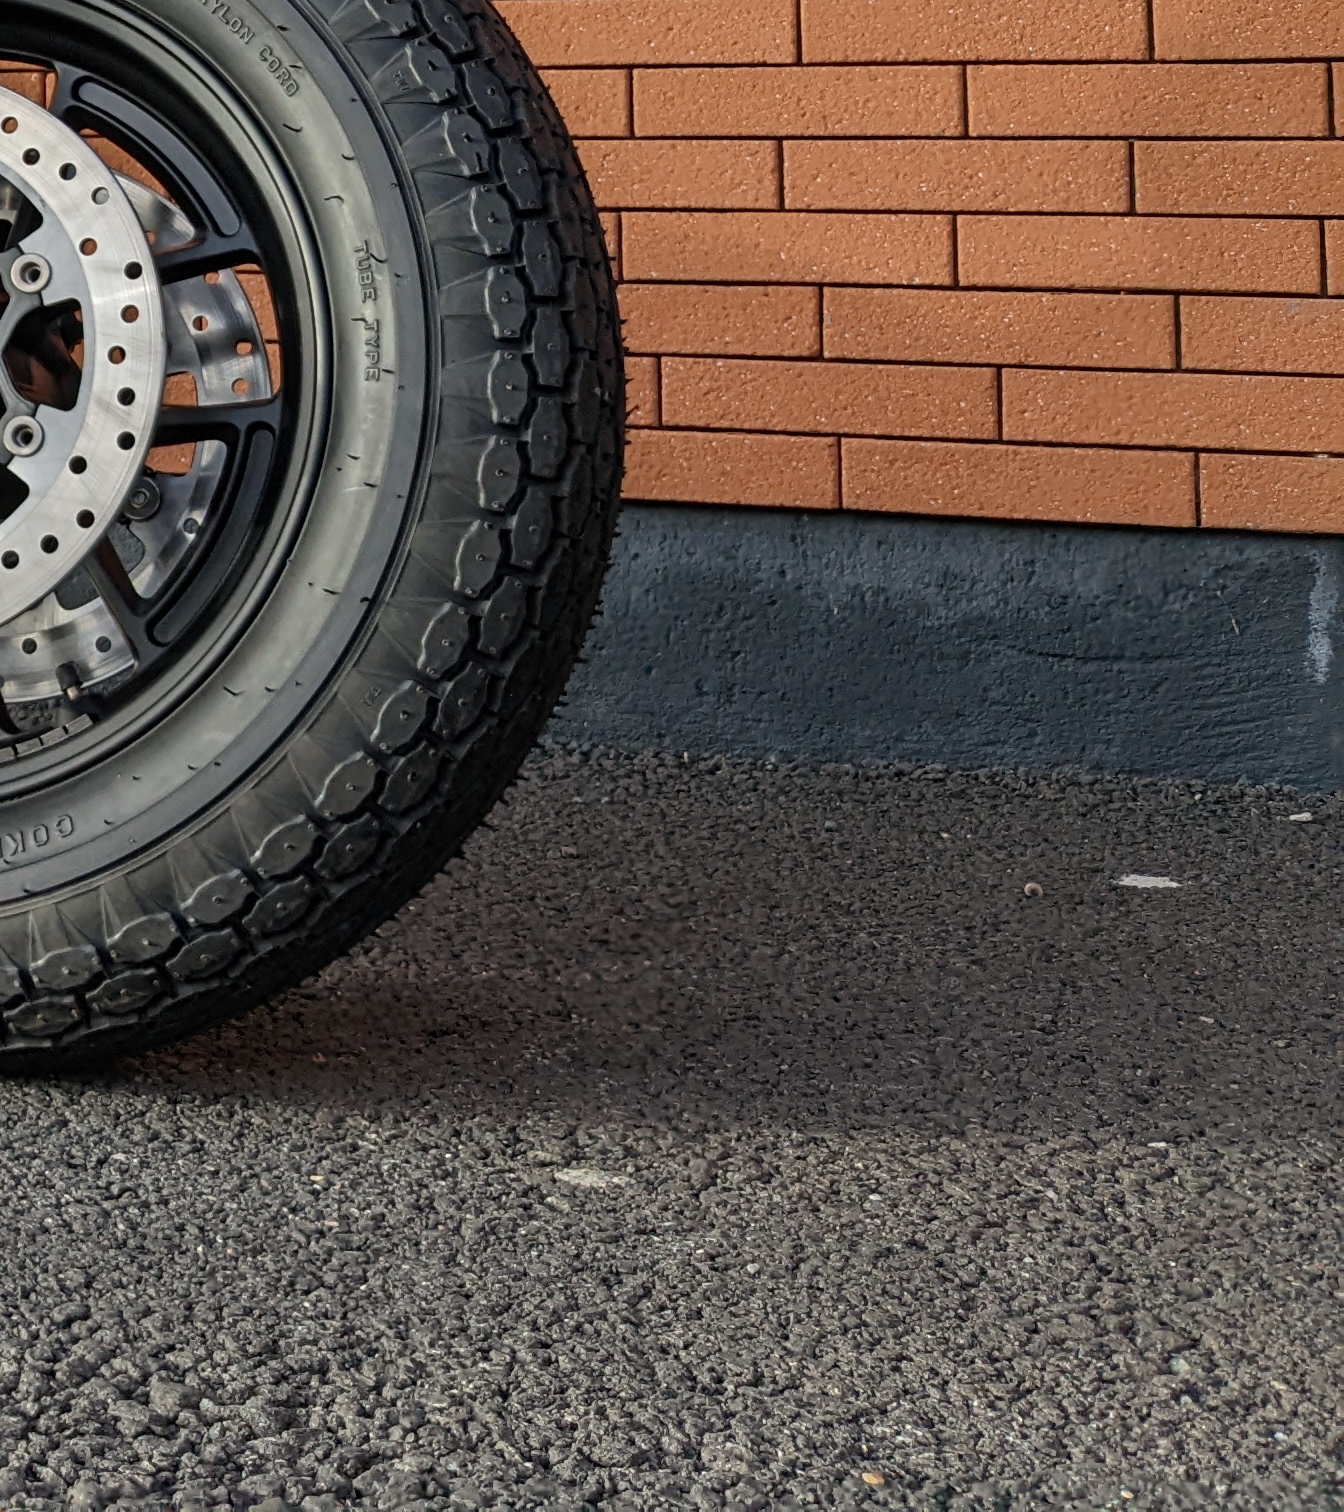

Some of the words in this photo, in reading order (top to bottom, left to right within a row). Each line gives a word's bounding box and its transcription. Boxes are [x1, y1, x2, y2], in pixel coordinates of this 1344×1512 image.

[258, 45, 301, 99] CORD
[353, 239, 379, 304] TUBE
[362, 318, 383, 383] TYPE
